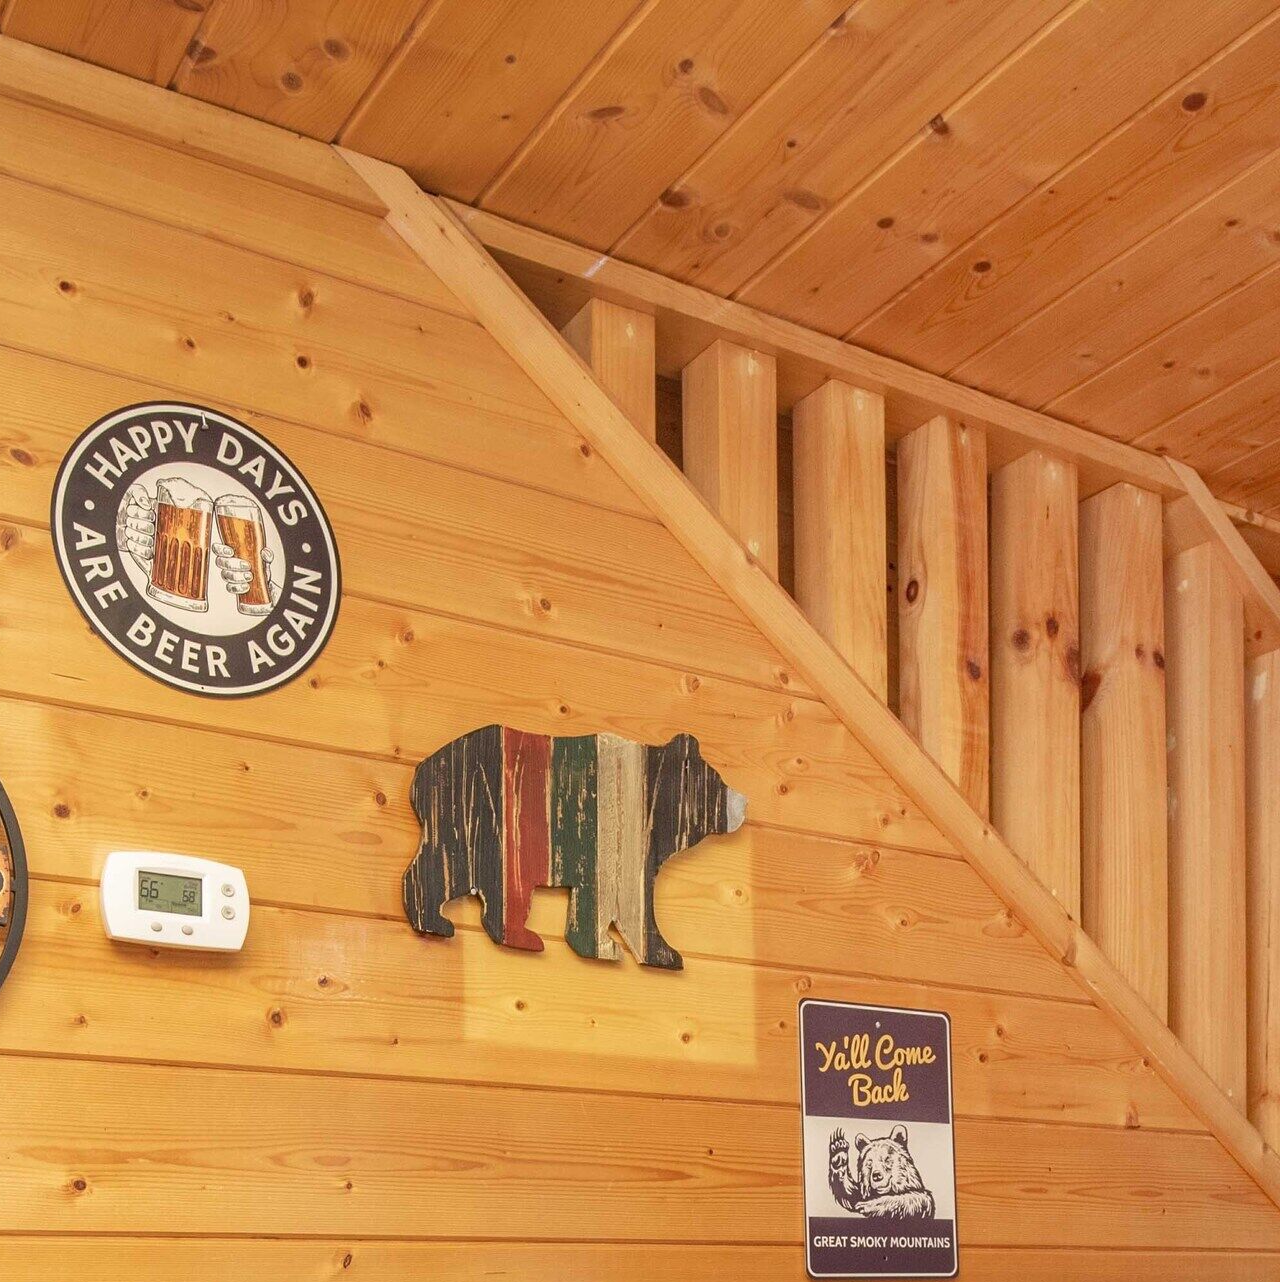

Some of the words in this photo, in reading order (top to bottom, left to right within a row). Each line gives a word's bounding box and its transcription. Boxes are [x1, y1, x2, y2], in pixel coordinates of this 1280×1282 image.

[84, 419, 199, 490] HAPPY
[216, 431, 307, 527] DAYS
[73, 521, 128, 609] ARE
[126, 612, 231, 678] BEER
[247, 565, 322, 674] AGAIN
[815, 1033, 872, 1073] Ya'll
[874, 1034, 936, 1070] Come
[847, 1067, 910, 1107] Back
[813, 1235, 848, 1248] GREAT
[849, 1236, 888, 1249] SMOKY
[889, 1236, 951, 1249] MOUNTAINS
